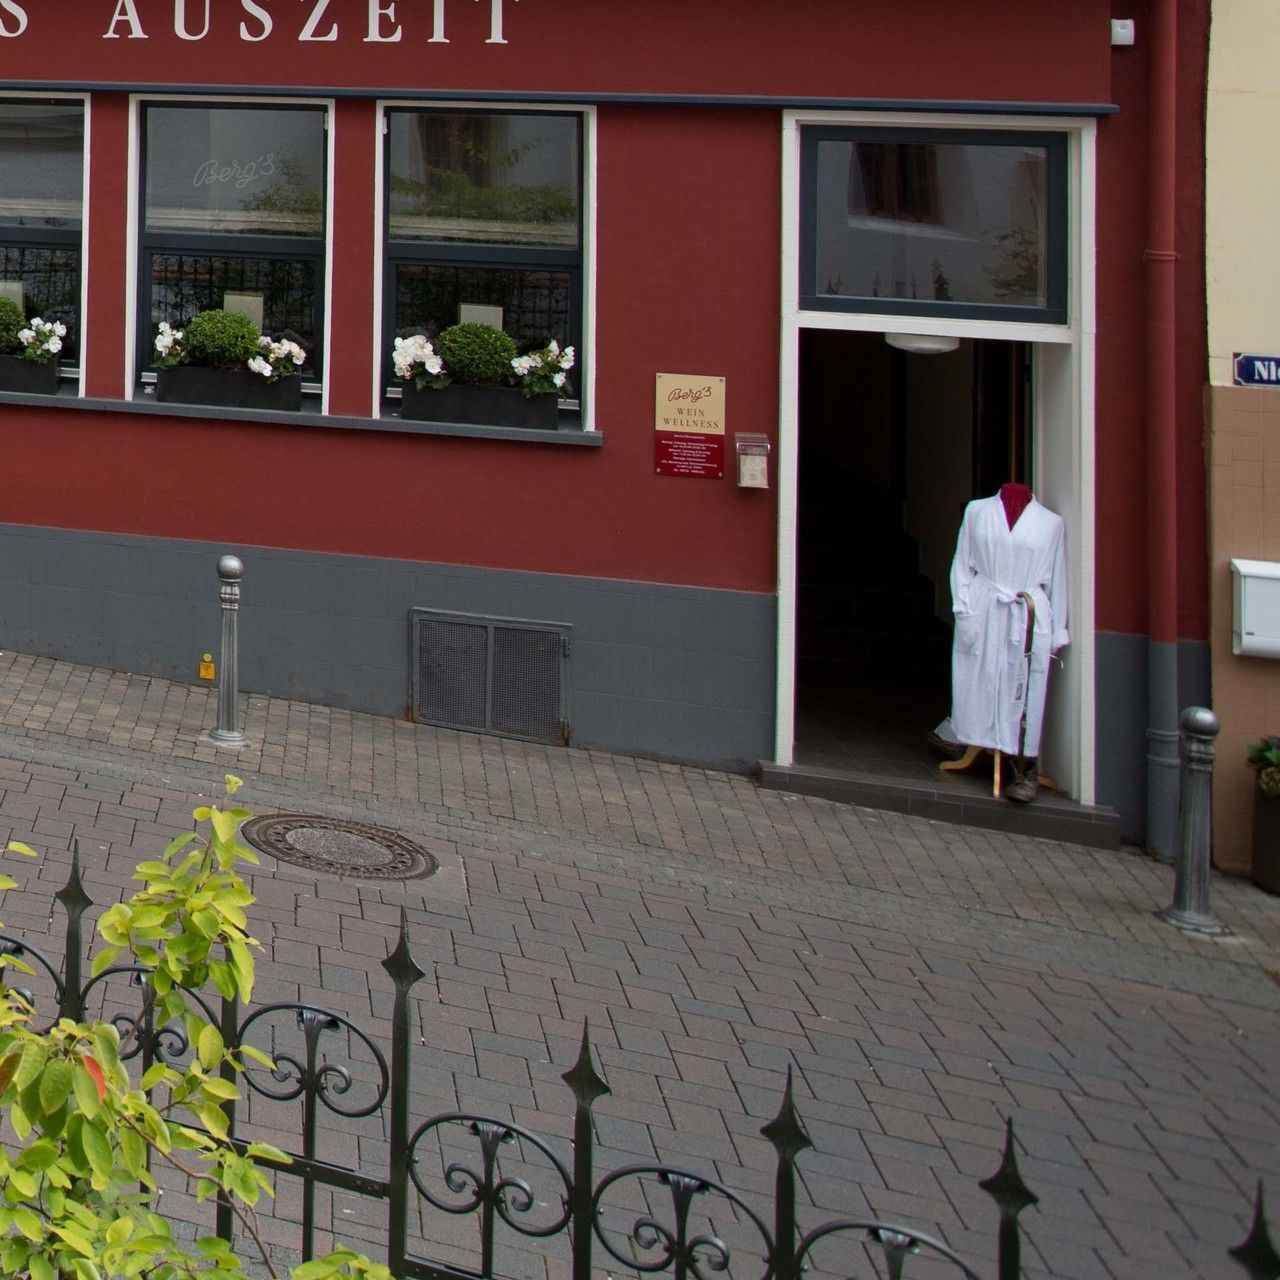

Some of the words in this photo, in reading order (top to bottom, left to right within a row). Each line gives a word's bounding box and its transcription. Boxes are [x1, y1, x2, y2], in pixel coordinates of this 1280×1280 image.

[193, 153, 275, 189] Berg's
[1253, 360, 1280, 381] Ni
[667, 385, 712, 404] Berg's
[676, 407, 705, 417] WEIN
[663, 417, 719, 429] WELLNESS
